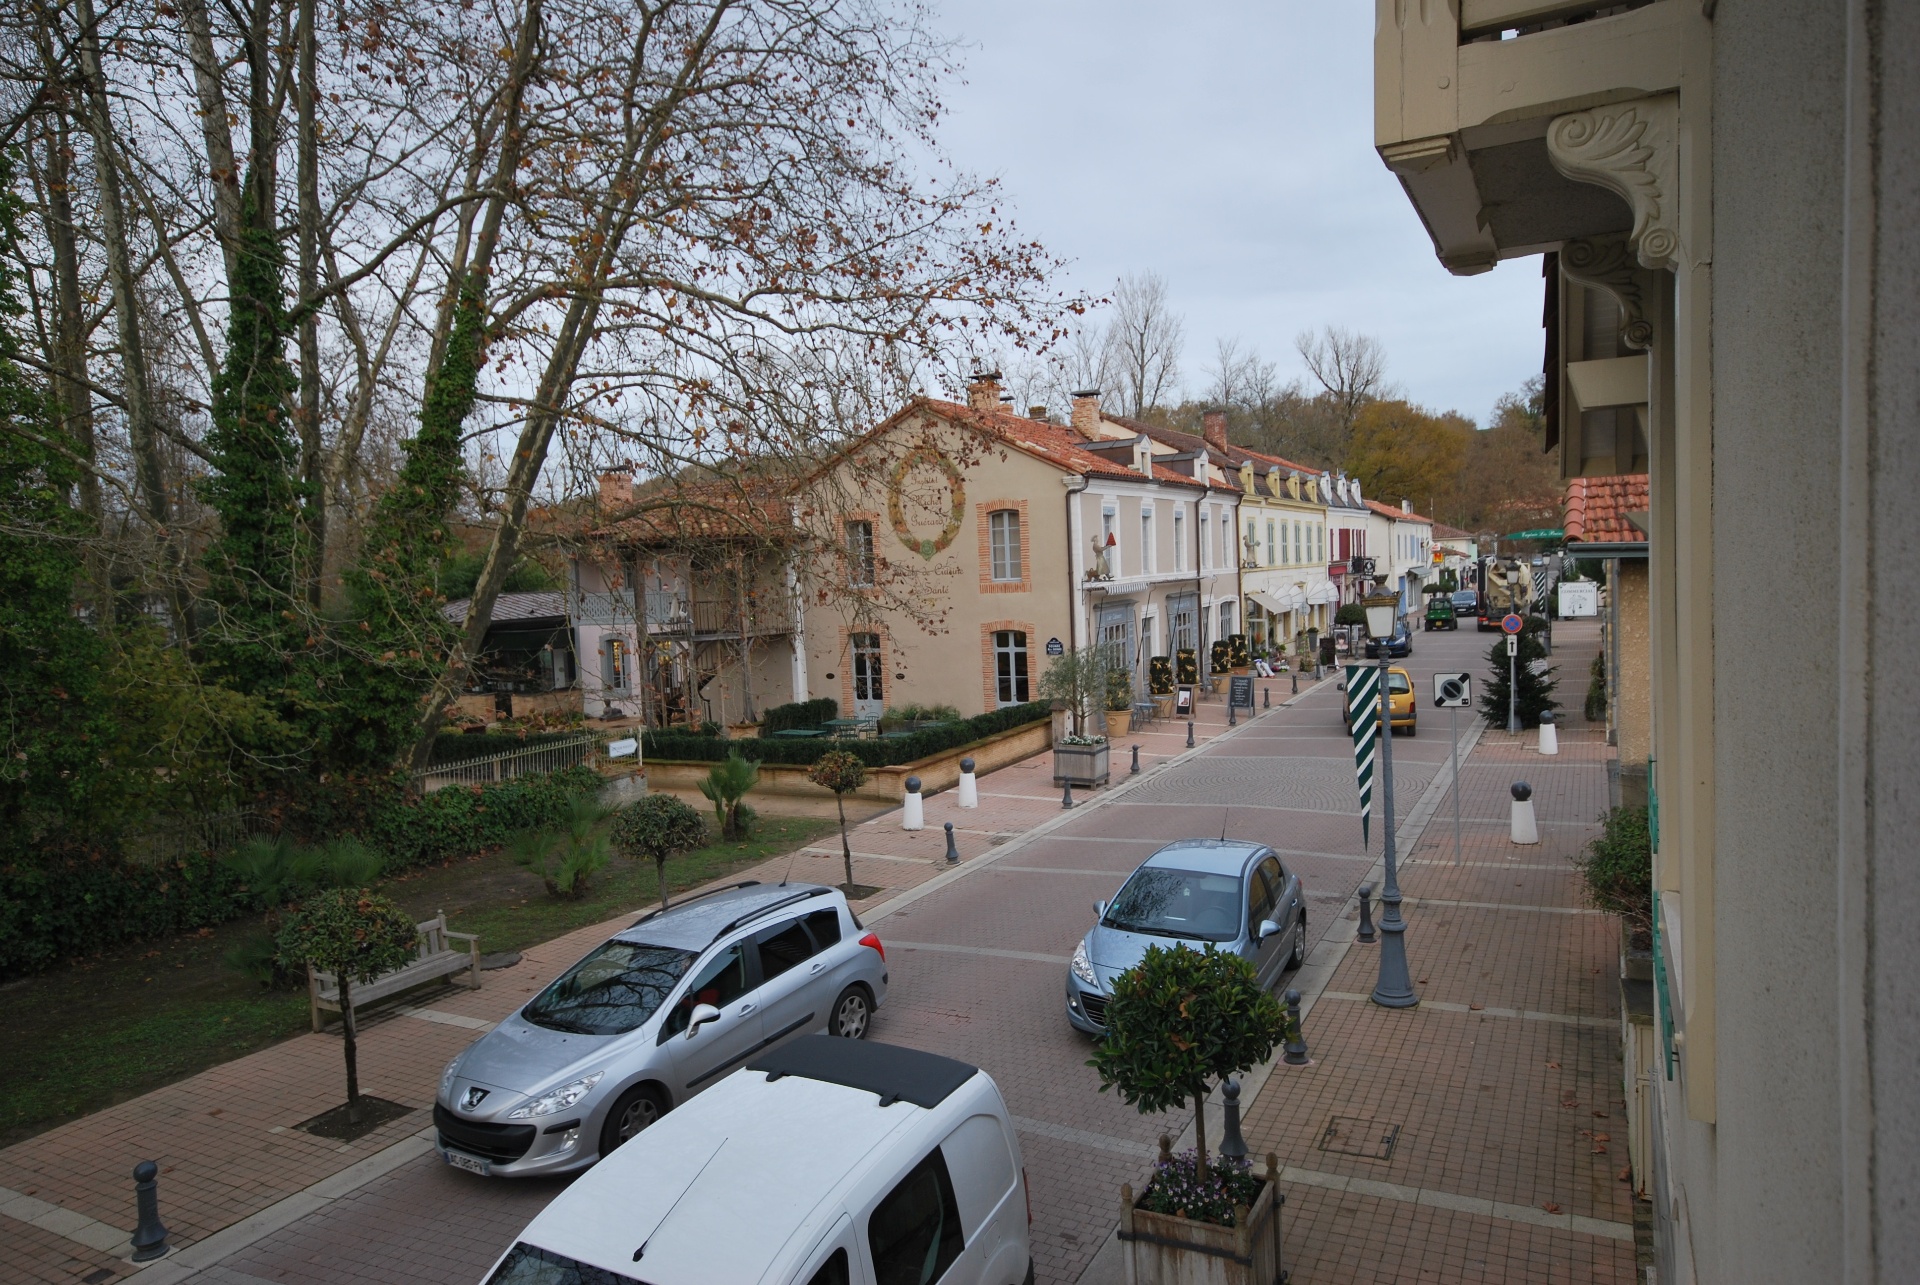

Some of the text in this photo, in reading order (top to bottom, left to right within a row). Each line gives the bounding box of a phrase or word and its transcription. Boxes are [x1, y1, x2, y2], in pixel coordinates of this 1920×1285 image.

[911, 494, 942, 506] Michel
[911, 514, 944, 527] Guérard
[934, 563, 964, 576] Cuisine
[924, 582, 950, 595] Santé
